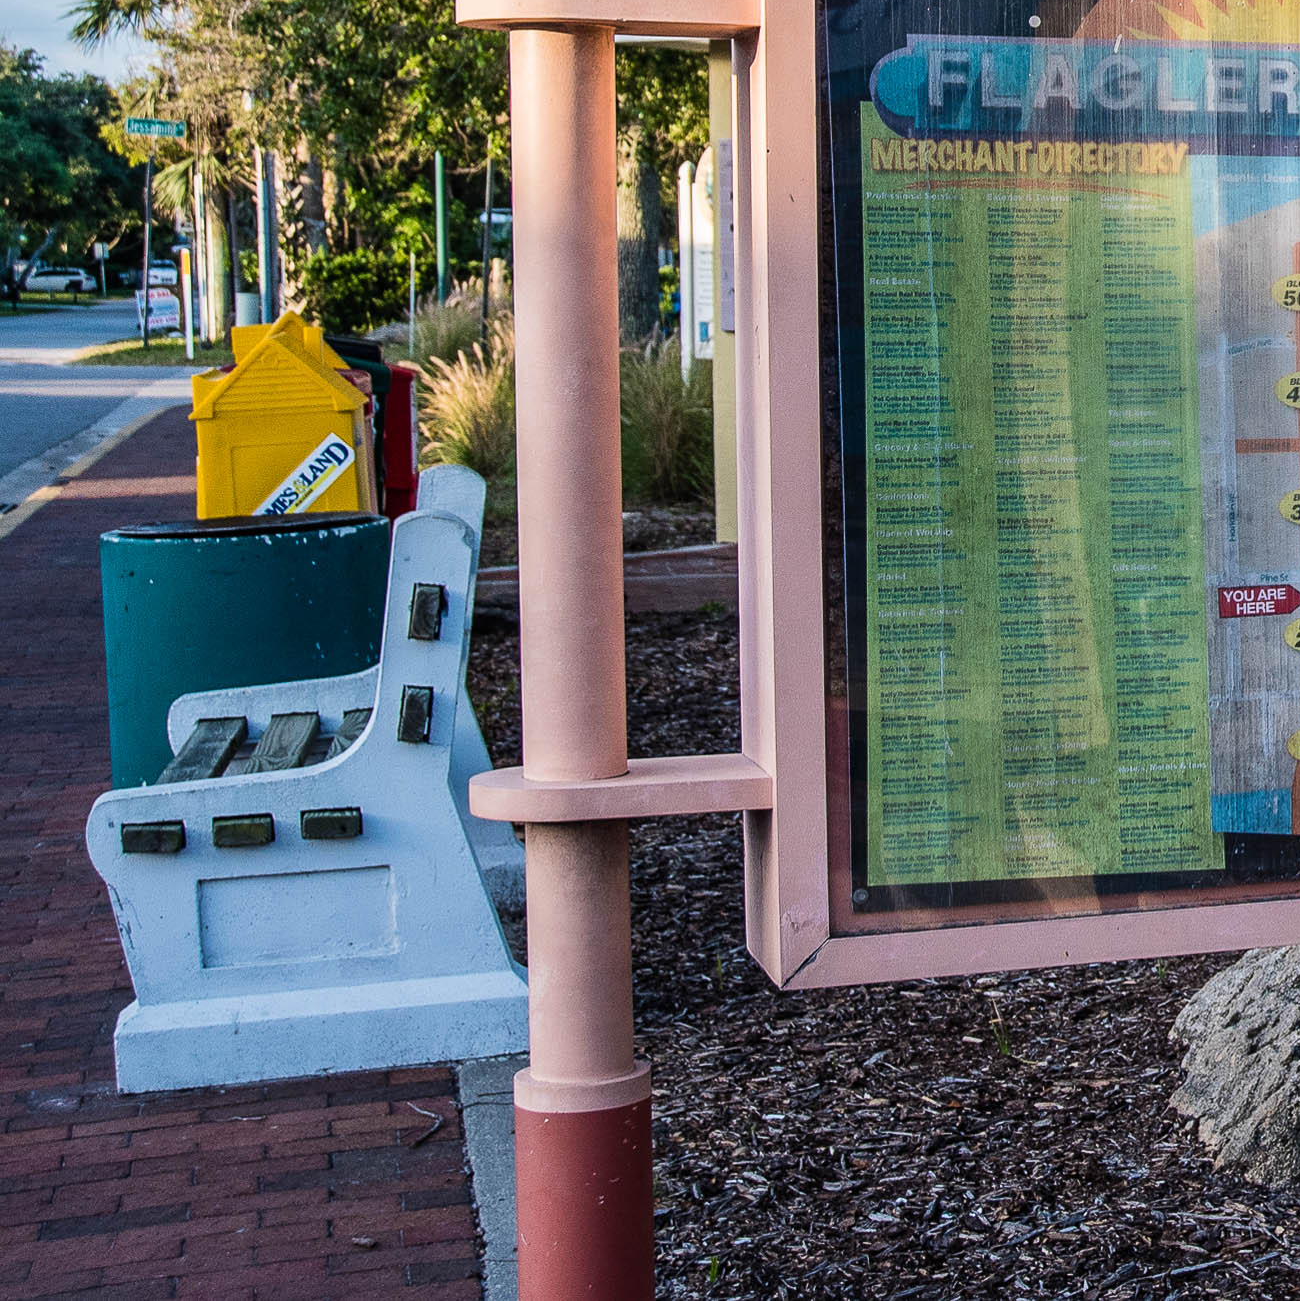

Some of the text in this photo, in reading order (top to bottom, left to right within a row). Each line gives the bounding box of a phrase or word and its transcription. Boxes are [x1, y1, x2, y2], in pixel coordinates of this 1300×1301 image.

[929, 50, 1300, 115] FLAGLER
[870, 138, 1188, 174] MERCHANT DIRECTORY
[298, 442, 349, 487] LAND
[1223, 587, 1287, 603] YOU ARE
[1236, 601, 1275, 614] HERE
